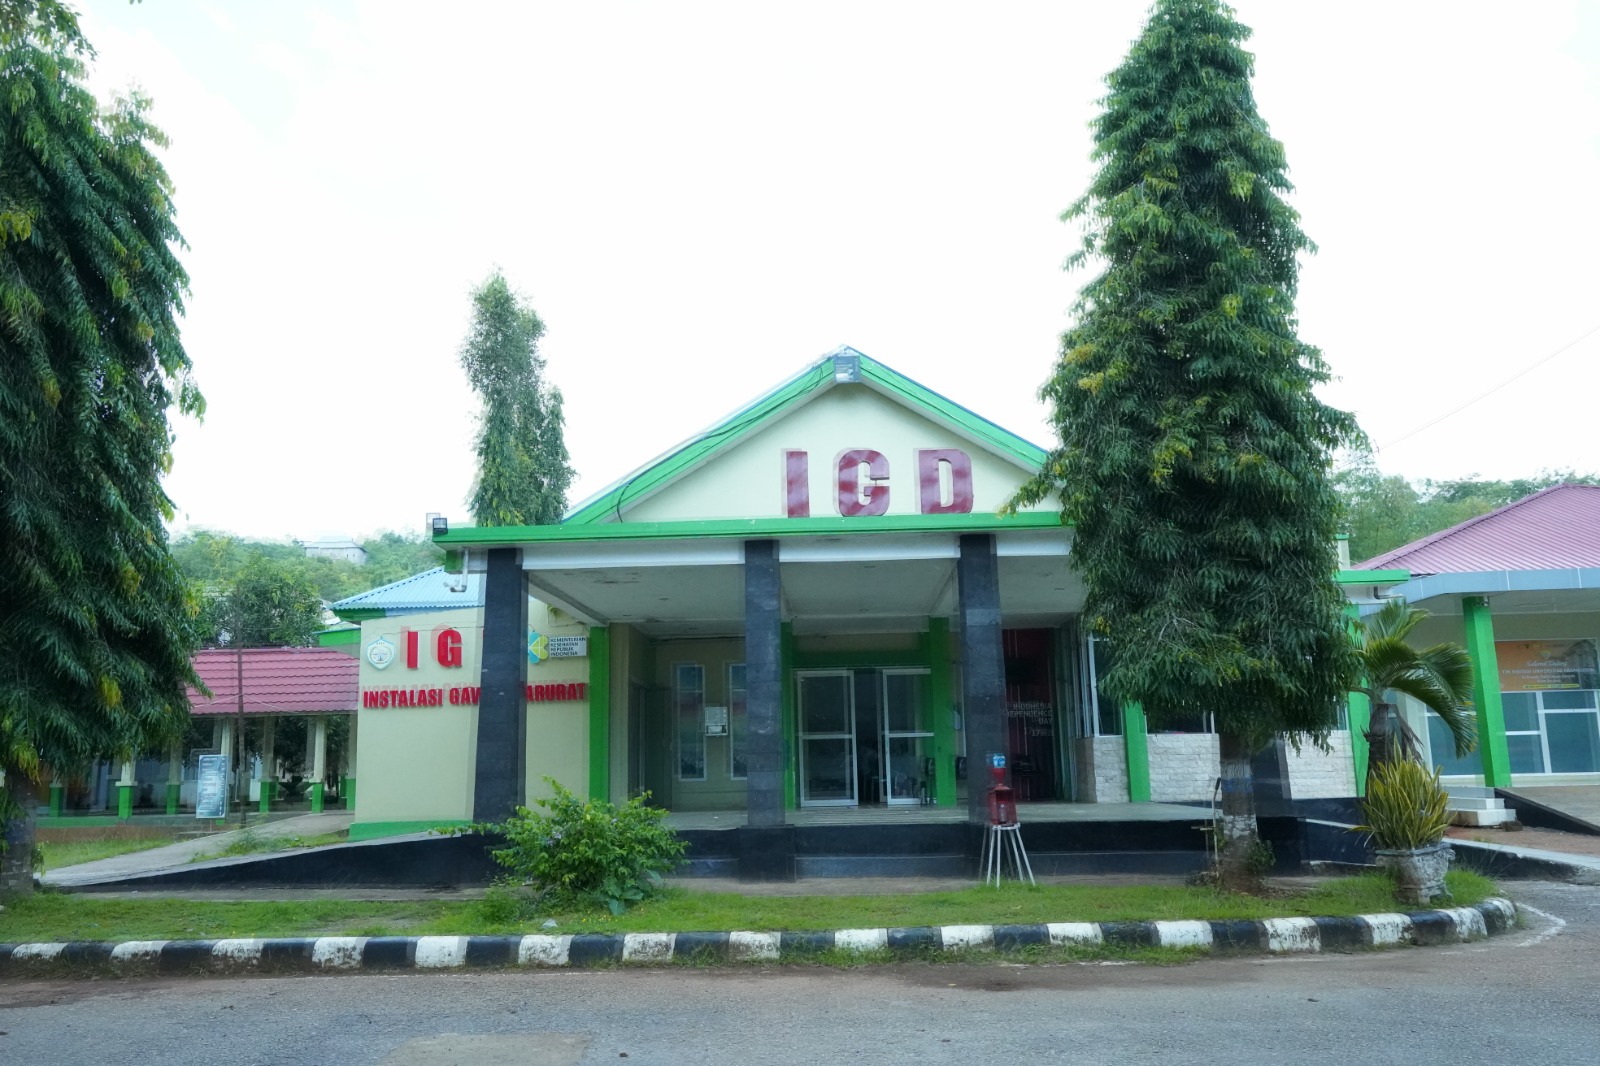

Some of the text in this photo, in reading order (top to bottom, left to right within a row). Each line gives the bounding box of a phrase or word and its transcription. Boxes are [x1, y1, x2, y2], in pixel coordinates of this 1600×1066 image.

[783, 448, 974, 517] IGD
[406, 628, 484, 669] IG
[363, 688, 443, 709] INSTALASI
[525, 682, 586, 702] ARURAT
